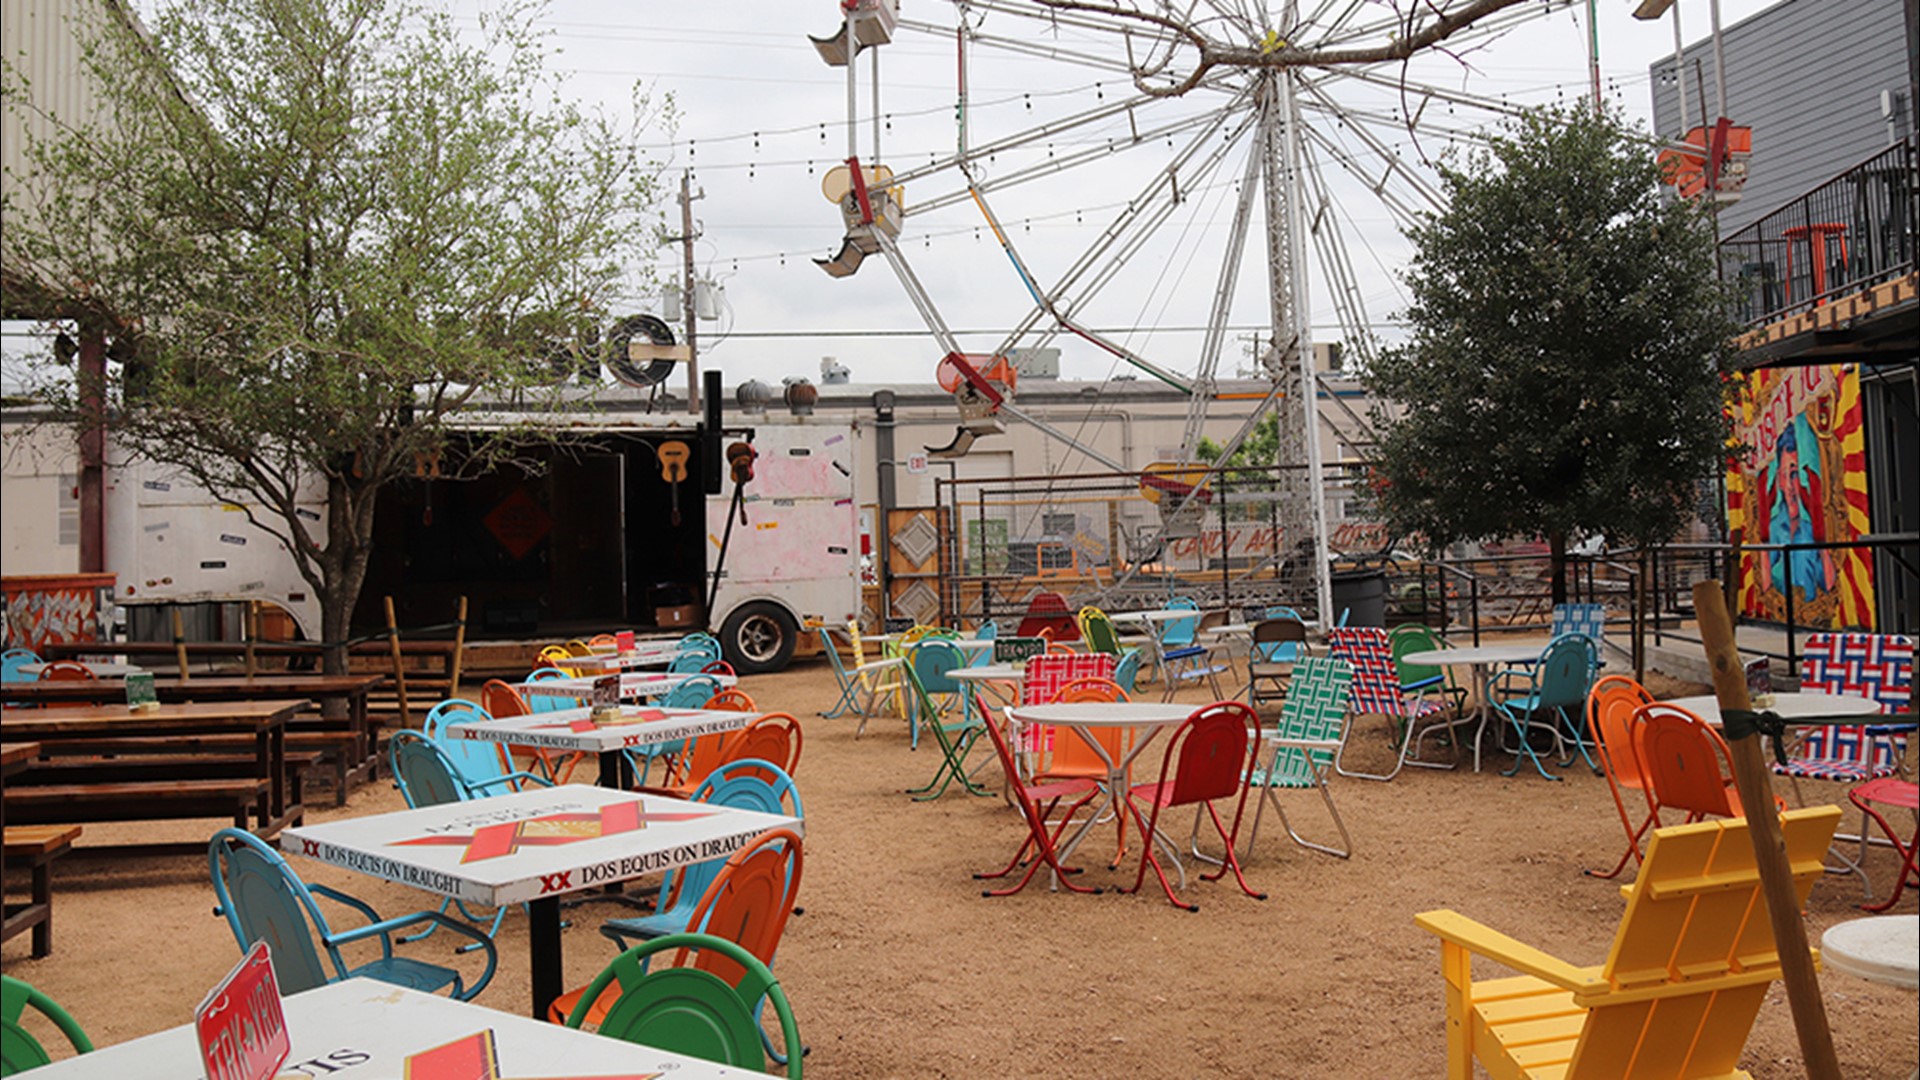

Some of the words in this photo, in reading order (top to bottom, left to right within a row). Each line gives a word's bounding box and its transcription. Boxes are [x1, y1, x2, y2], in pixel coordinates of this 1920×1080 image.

[623, 735, 640, 747] XX
[302, 839, 320, 858] XX
[325, 844, 347, 862] DOS
[348, 848, 381, 873] EQUIS
[382, 857, 400, 878] ON
[403, 863, 462, 895] DRAUGHT
[539, 870, 573, 894] XX
[582, 861, 617, 884] DOS
[621, 848, 670, 874] EQUIS
[673, 842, 698, 863] ON
[702, 828, 768, 858] DRAUG
[209, 1013, 253, 1080] TRK
[247, 973, 282, 1054] YRD
